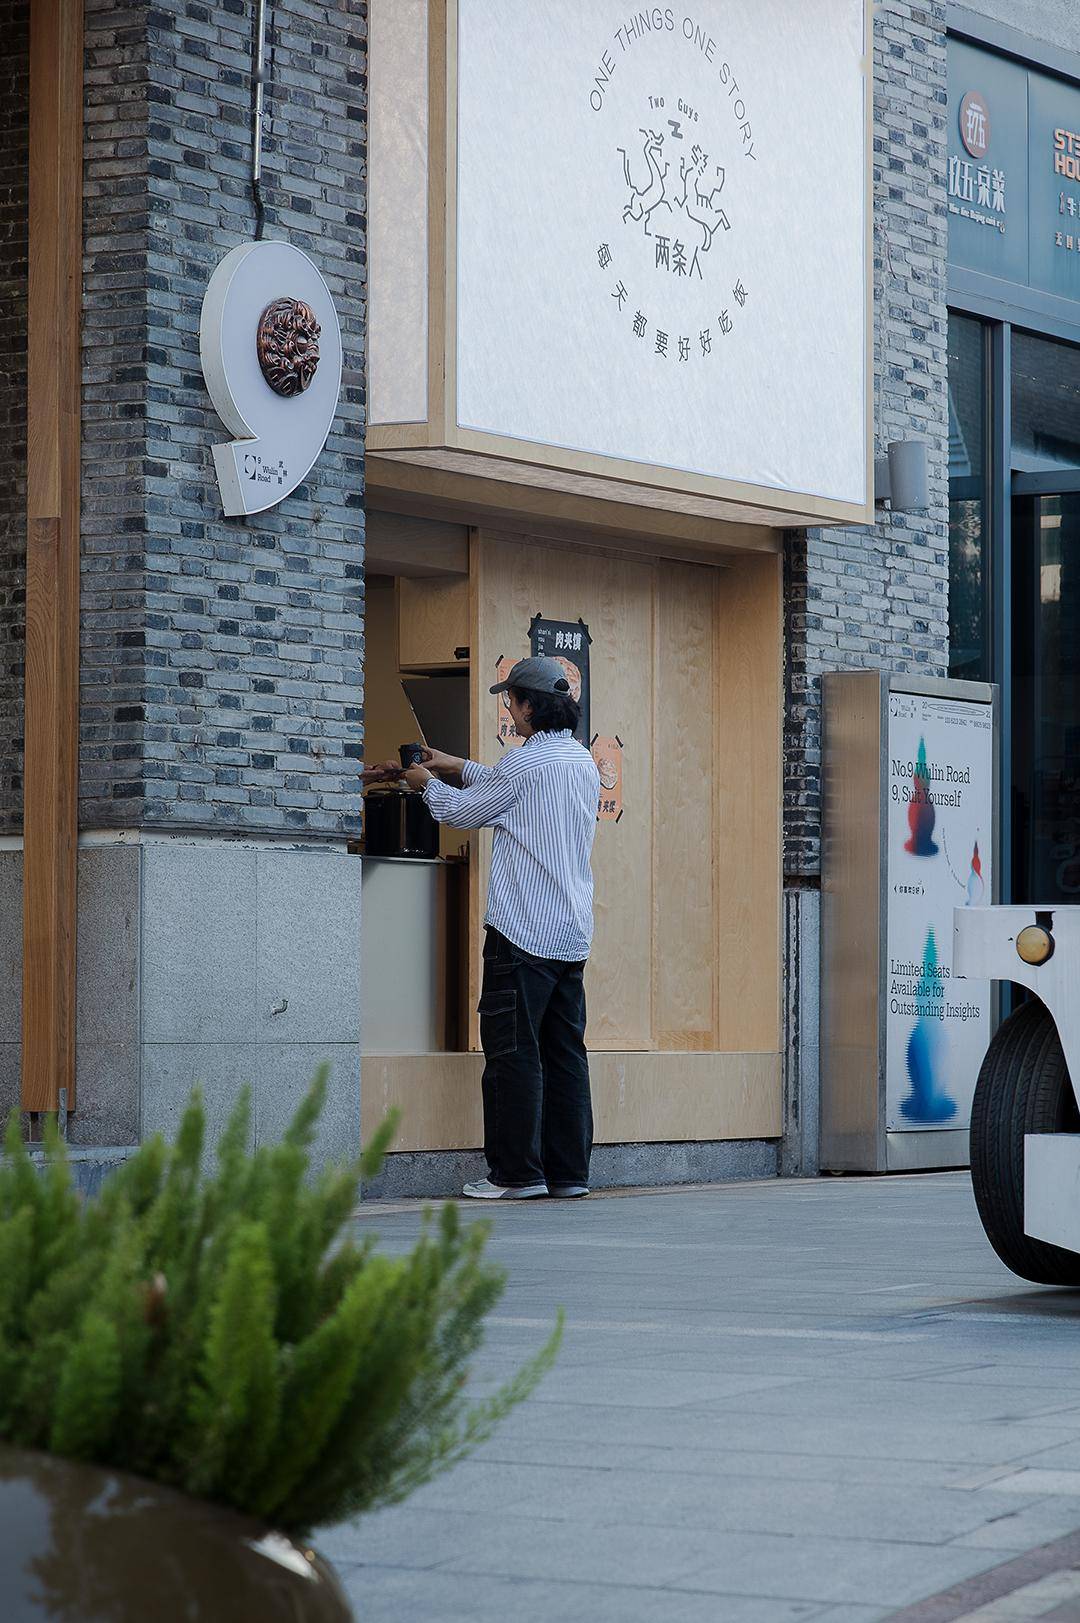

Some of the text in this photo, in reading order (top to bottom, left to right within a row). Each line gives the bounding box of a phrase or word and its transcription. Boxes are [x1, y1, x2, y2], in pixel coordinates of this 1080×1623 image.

[590, 8, 756, 160] ONE THINGS ONE STORY
[655, 234, 703, 280] 两条人
[892, 760, 970, 784] No.9 Wulin Road
[902, 786, 921, 803] Suit
[922, 788, 962, 807] Yourself
[891, 960, 950, 978] Limited Seats
[891, 980, 945, 998] Available for
[890, 999, 980, 1021] Outstanding Insights
